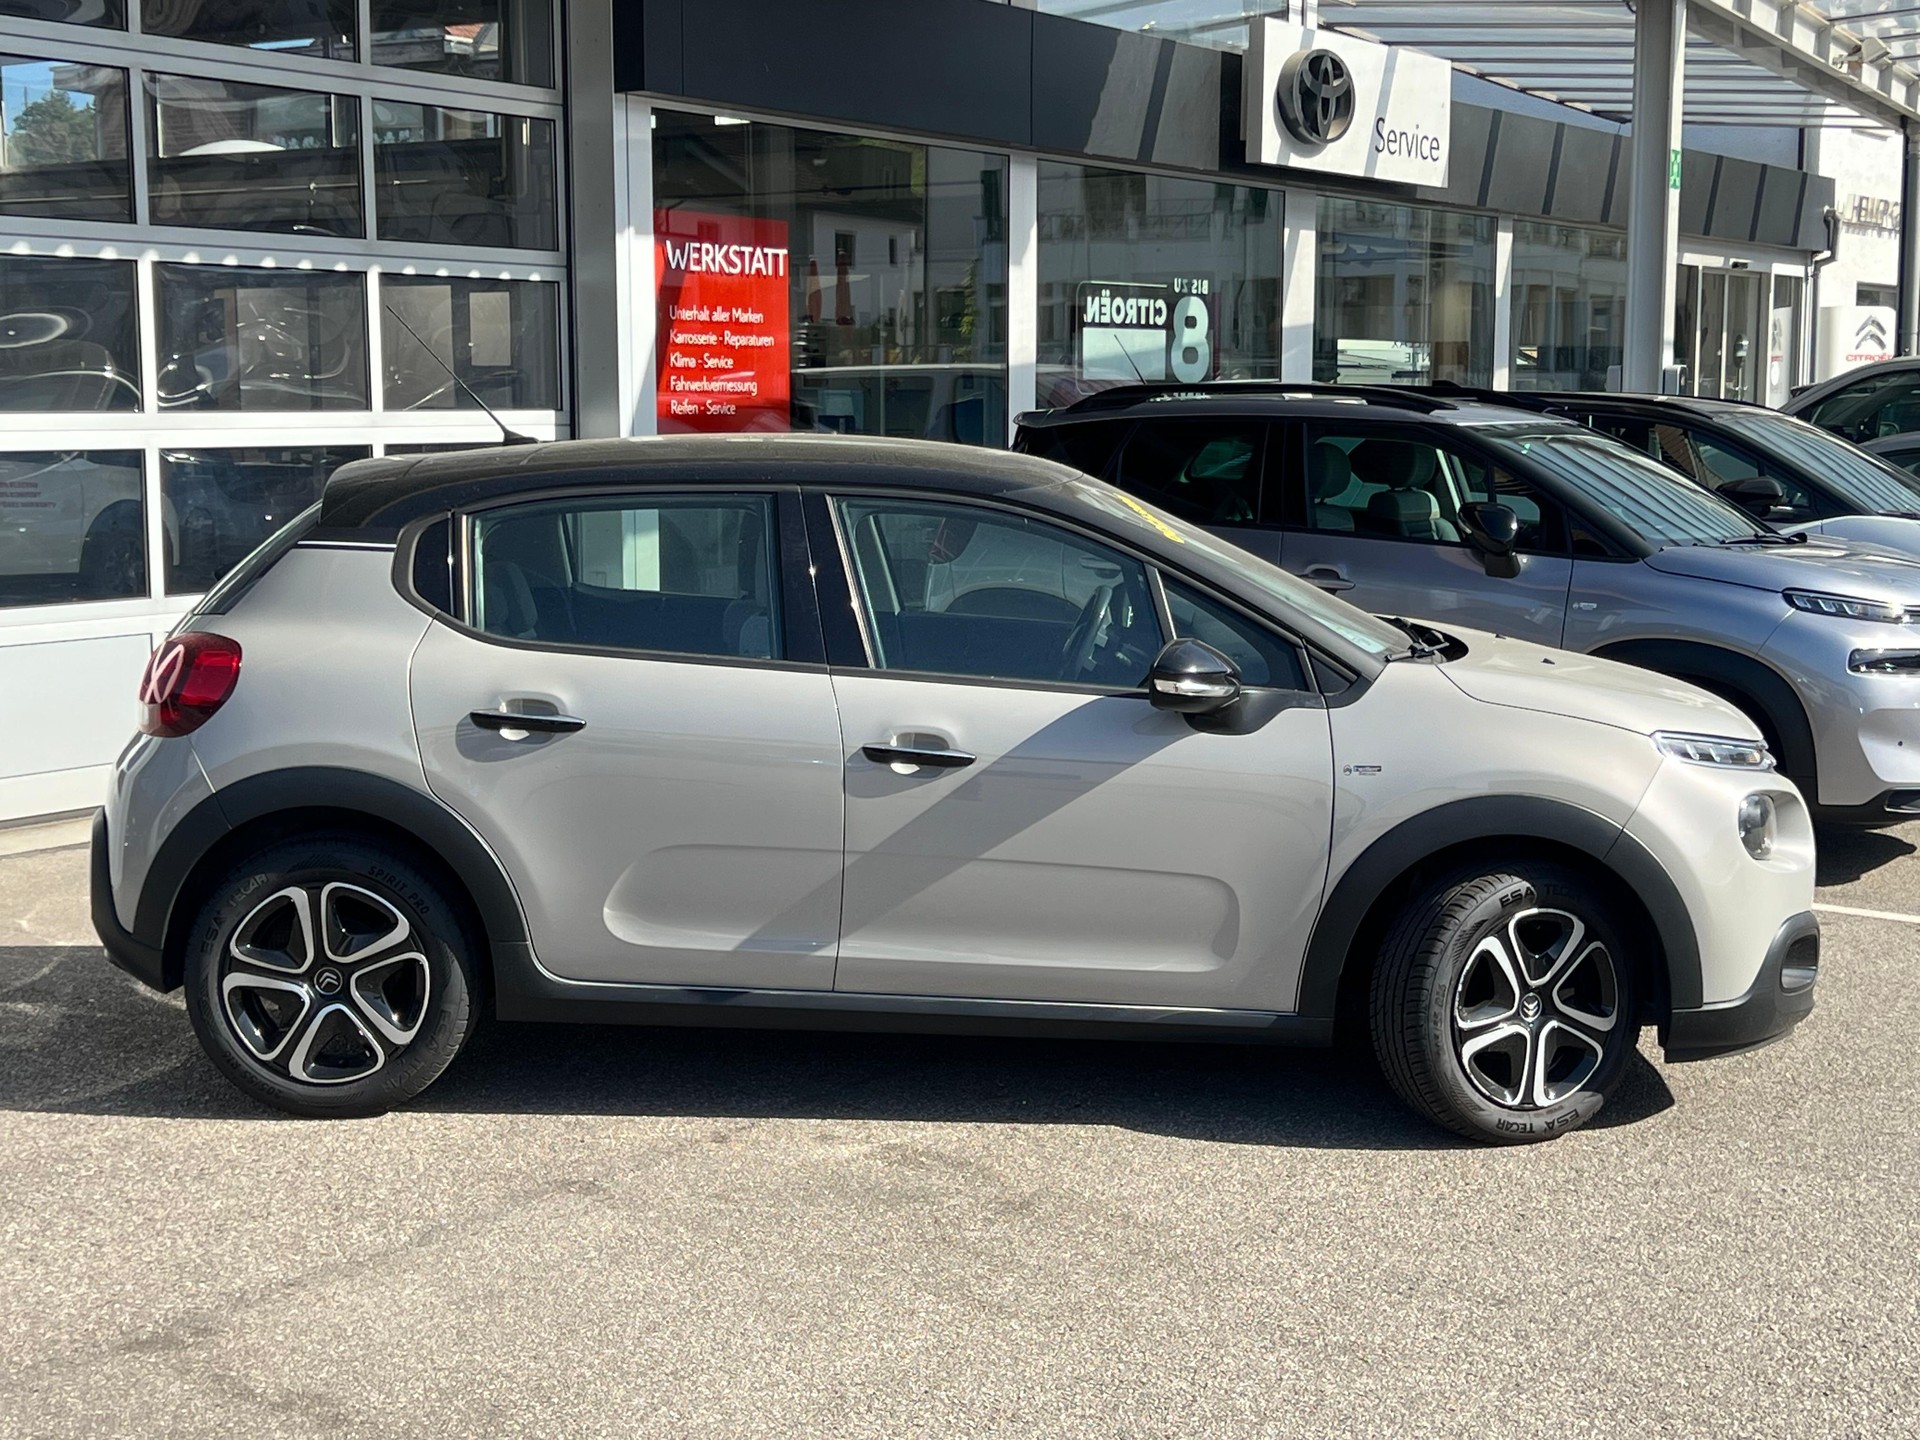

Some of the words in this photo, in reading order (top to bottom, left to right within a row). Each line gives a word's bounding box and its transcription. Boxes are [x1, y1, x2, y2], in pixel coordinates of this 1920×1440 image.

[1374, 117, 1440, 162] Service
[665, 239, 788, 277] WERKSTATT
[669, 304, 710, 321] Unterhalt
[711, 306, 731, 322] aller
[732, 307, 764, 323] Marken
[724, 330, 775, 349] Reparaturen
[669, 351, 697, 368] Klima
[703, 352, 734, 368] Service
[670, 375, 758, 396] Fahrwerkvermessung
[670, 398, 699, 415] Reifen
[706, 399, 737, 415] Service
[230, 872, 269, 908] TECAR
[367, 865, 407, 893] SPIRIT
[408, 890, 431, 916] PRO
[1495, 1116, 1536, 1134] TECAR
